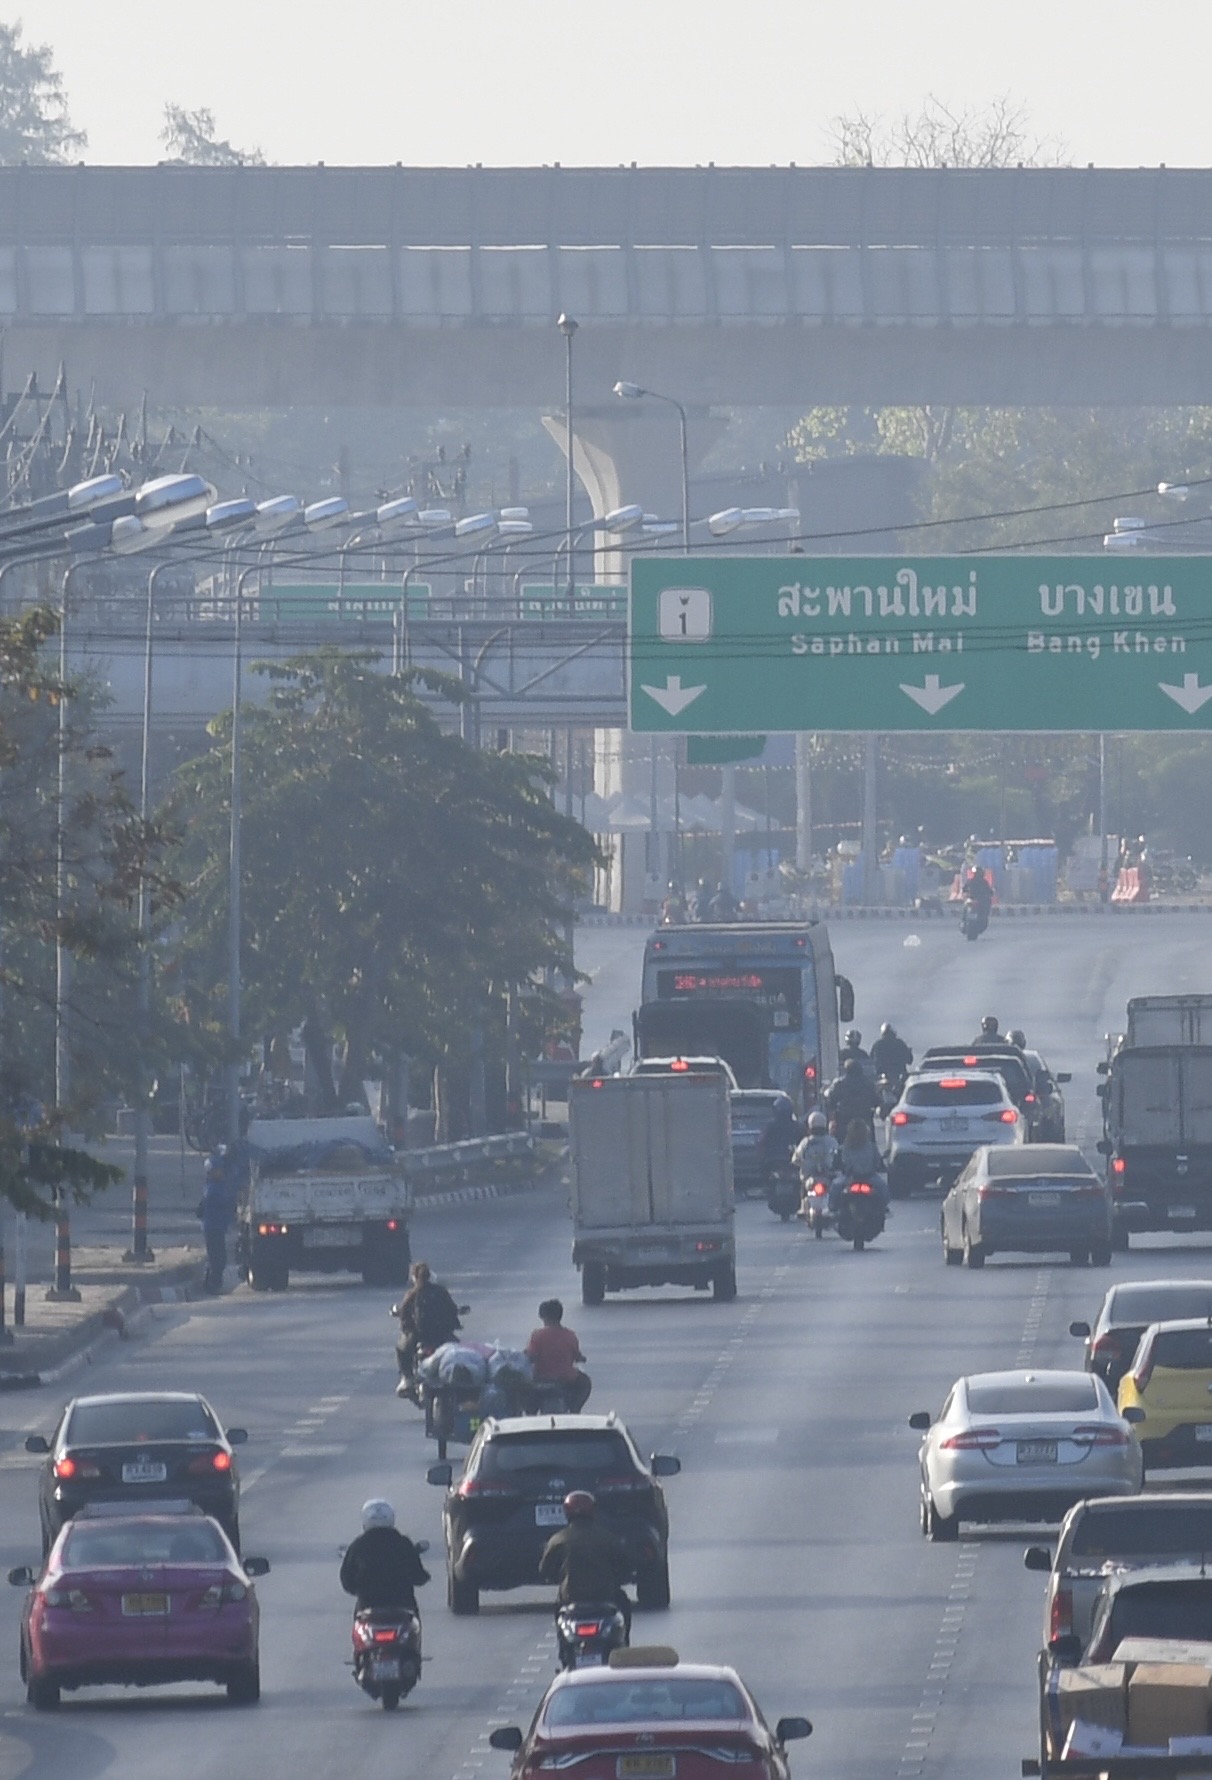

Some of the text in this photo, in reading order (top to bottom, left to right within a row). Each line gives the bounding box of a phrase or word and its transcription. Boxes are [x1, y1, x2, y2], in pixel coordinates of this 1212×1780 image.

[778, 569, 1177, 616] สะพานใหม่ บางเขน
[791, 631, 1186, 660] Saphan Mai Bang Khen
